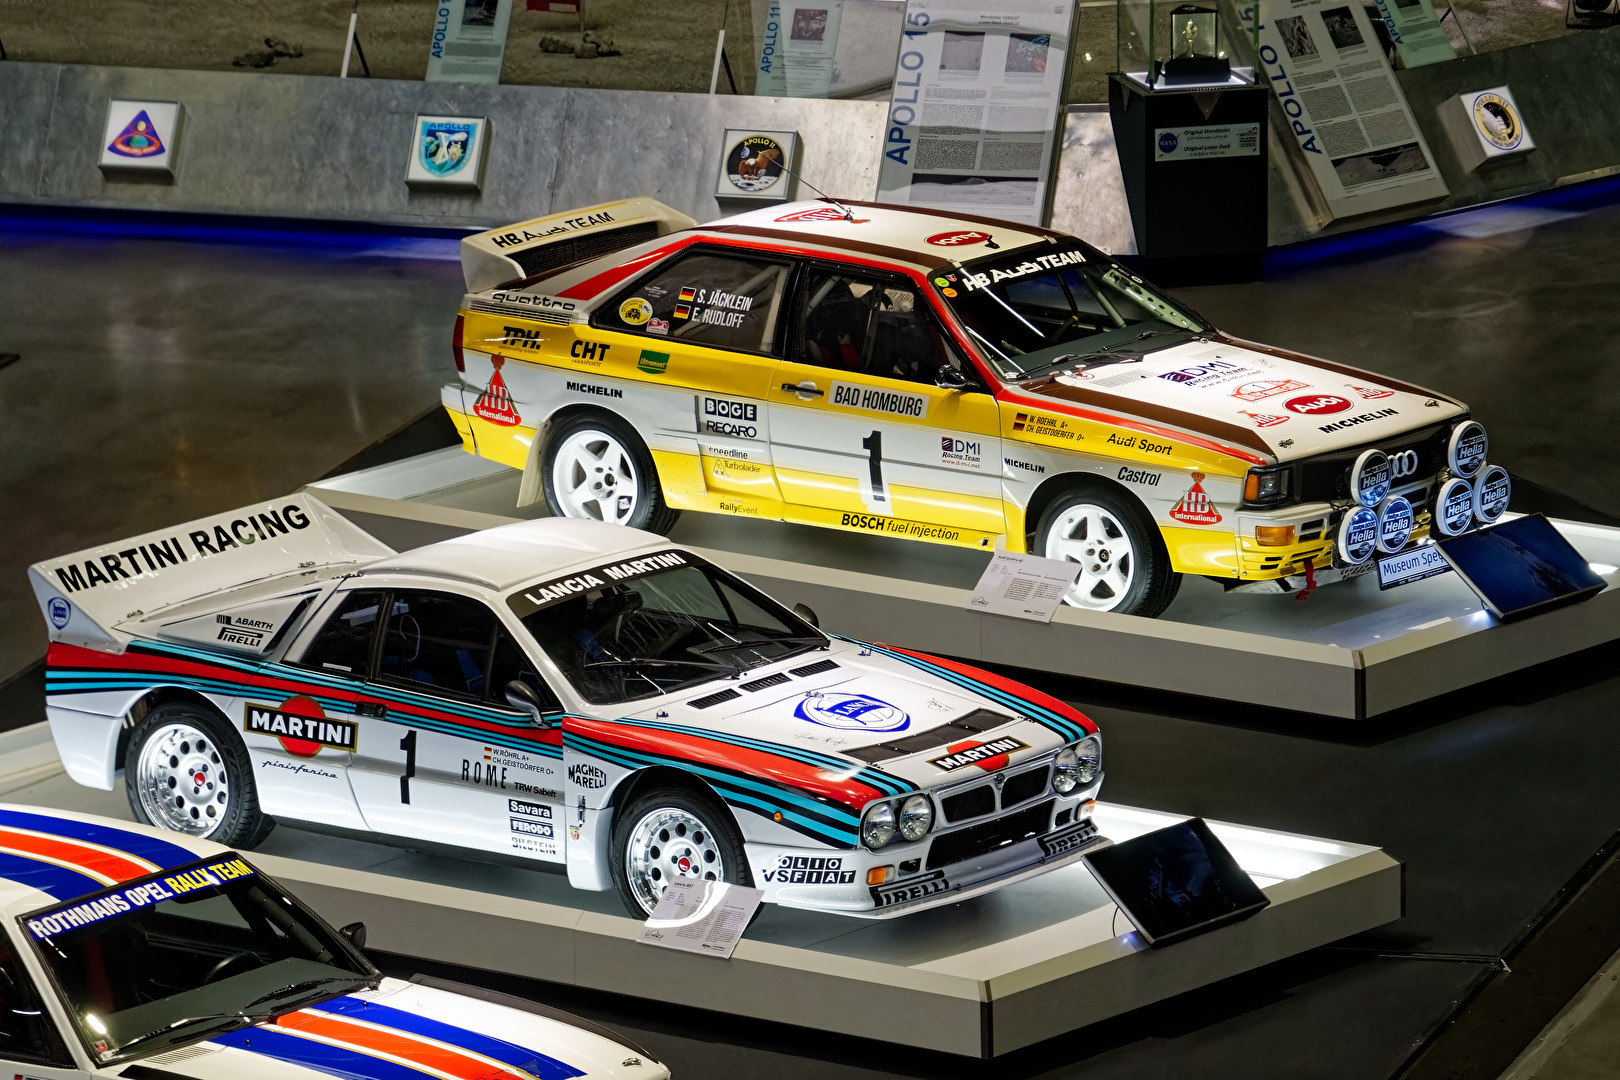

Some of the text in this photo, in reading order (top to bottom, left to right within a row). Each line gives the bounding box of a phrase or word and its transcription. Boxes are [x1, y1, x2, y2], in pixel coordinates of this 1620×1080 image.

[431, 8, 450, 59] APOLLO
[760, 7, 781, 73] APOLLO 11
[886, 12, 931, 166] APOLLO 15
[1259, 44, 1323, 155] APOLLO
[744, 137, 770, 147] APOLLO
[492, 211, 616, 248] HB Audi TEAM
[961, 272, 990, 292] HB
[989, 262, 1040, 283] Audi
[1037, 250, 1087, 270] TEAM
[492, 293, 576, 311] quattro
[697, 289, 753, 312] S. JÄCKLEIN
[691, 306, 745, 328] E. RUDLOFF
[570, 339, 611, 361] CHT
[1179, 360, 1237, 376] DMI
[1184, 366, 1248, 387] Racing Team
[566, 381, 623, 399] MICHELIN
[705, 398, 757, 421] BOGE
[834, 385, 923, 417] BAD HOMBURG
[1292, 397, 1344, 413] Audi
[479, 407, 516, 424] international
[1029, 415, 1036, 423] W.
[1036, 416, 1057, 428] ROEHRL
[1318, 408, 1400, 434] MICHELIN
[706, 420, 757, 439] RECARO
[954, 439, 981, 456] DMI
[1106, 433, 1173, 456] Audi Sport
[1459, 443, 1483, 459] Hella
[723, 459, 761, 474] Turbolader
[862, 430, 886, 502] 1
[941, 451, 981, 462] Racing Team
[1004, 457, 1045, 474] MICHELIN
[1117, 466, 1162, 487] Castrol
[1362, 471, 1387, 489] Hella
[1182, 490, 1210, 514] HB
[1484, 487, 1507, 504] Hella
[719, 502, 758, 515] RallyEvent
[1174, 512, 1218, 523] international
[1447, 501, 1470, 517] Hella
[840, 513, 960, 541] BOSCH fuel injection
[1384, 518, 1409, 533] Hella
[1349, 529, 1375, 544] Hella
[54, 504, 311, 593] MARTINI RACING
[1383, 556, 1421, 577] Museum
[524, 552, 687, 606] LANCIA MARTINI
[234, 617, 274, 630] ABARTH
[217, 627, 264, 648] PIRELLI
[251, 710, 351, 745] MARTINI
[521, 754, 530, 762] A+
[935, 738, 1021, 770] MARTINI
[262, 760, 338, 779] pininfarina
[399, 729, 418, 805] 1
[461, 759, 508, 790] ROME
[568, 764, 607, 779] MAGNETI
[514, 781, 557, 798] TRW Sabelt
[568, 775, 607, 789] MARELLI
[510, 800, 551, 817] Savara
[512, 820, 551, 835] FERODO
[1037, 818, 1098, 857] PIRELLI
[779, 856, 841, 870] OLIO
[27, 858, 255, 938] ROTHMANS OPEL RALLY TEAM
[868, 869, 950, 908] PIRELLI
